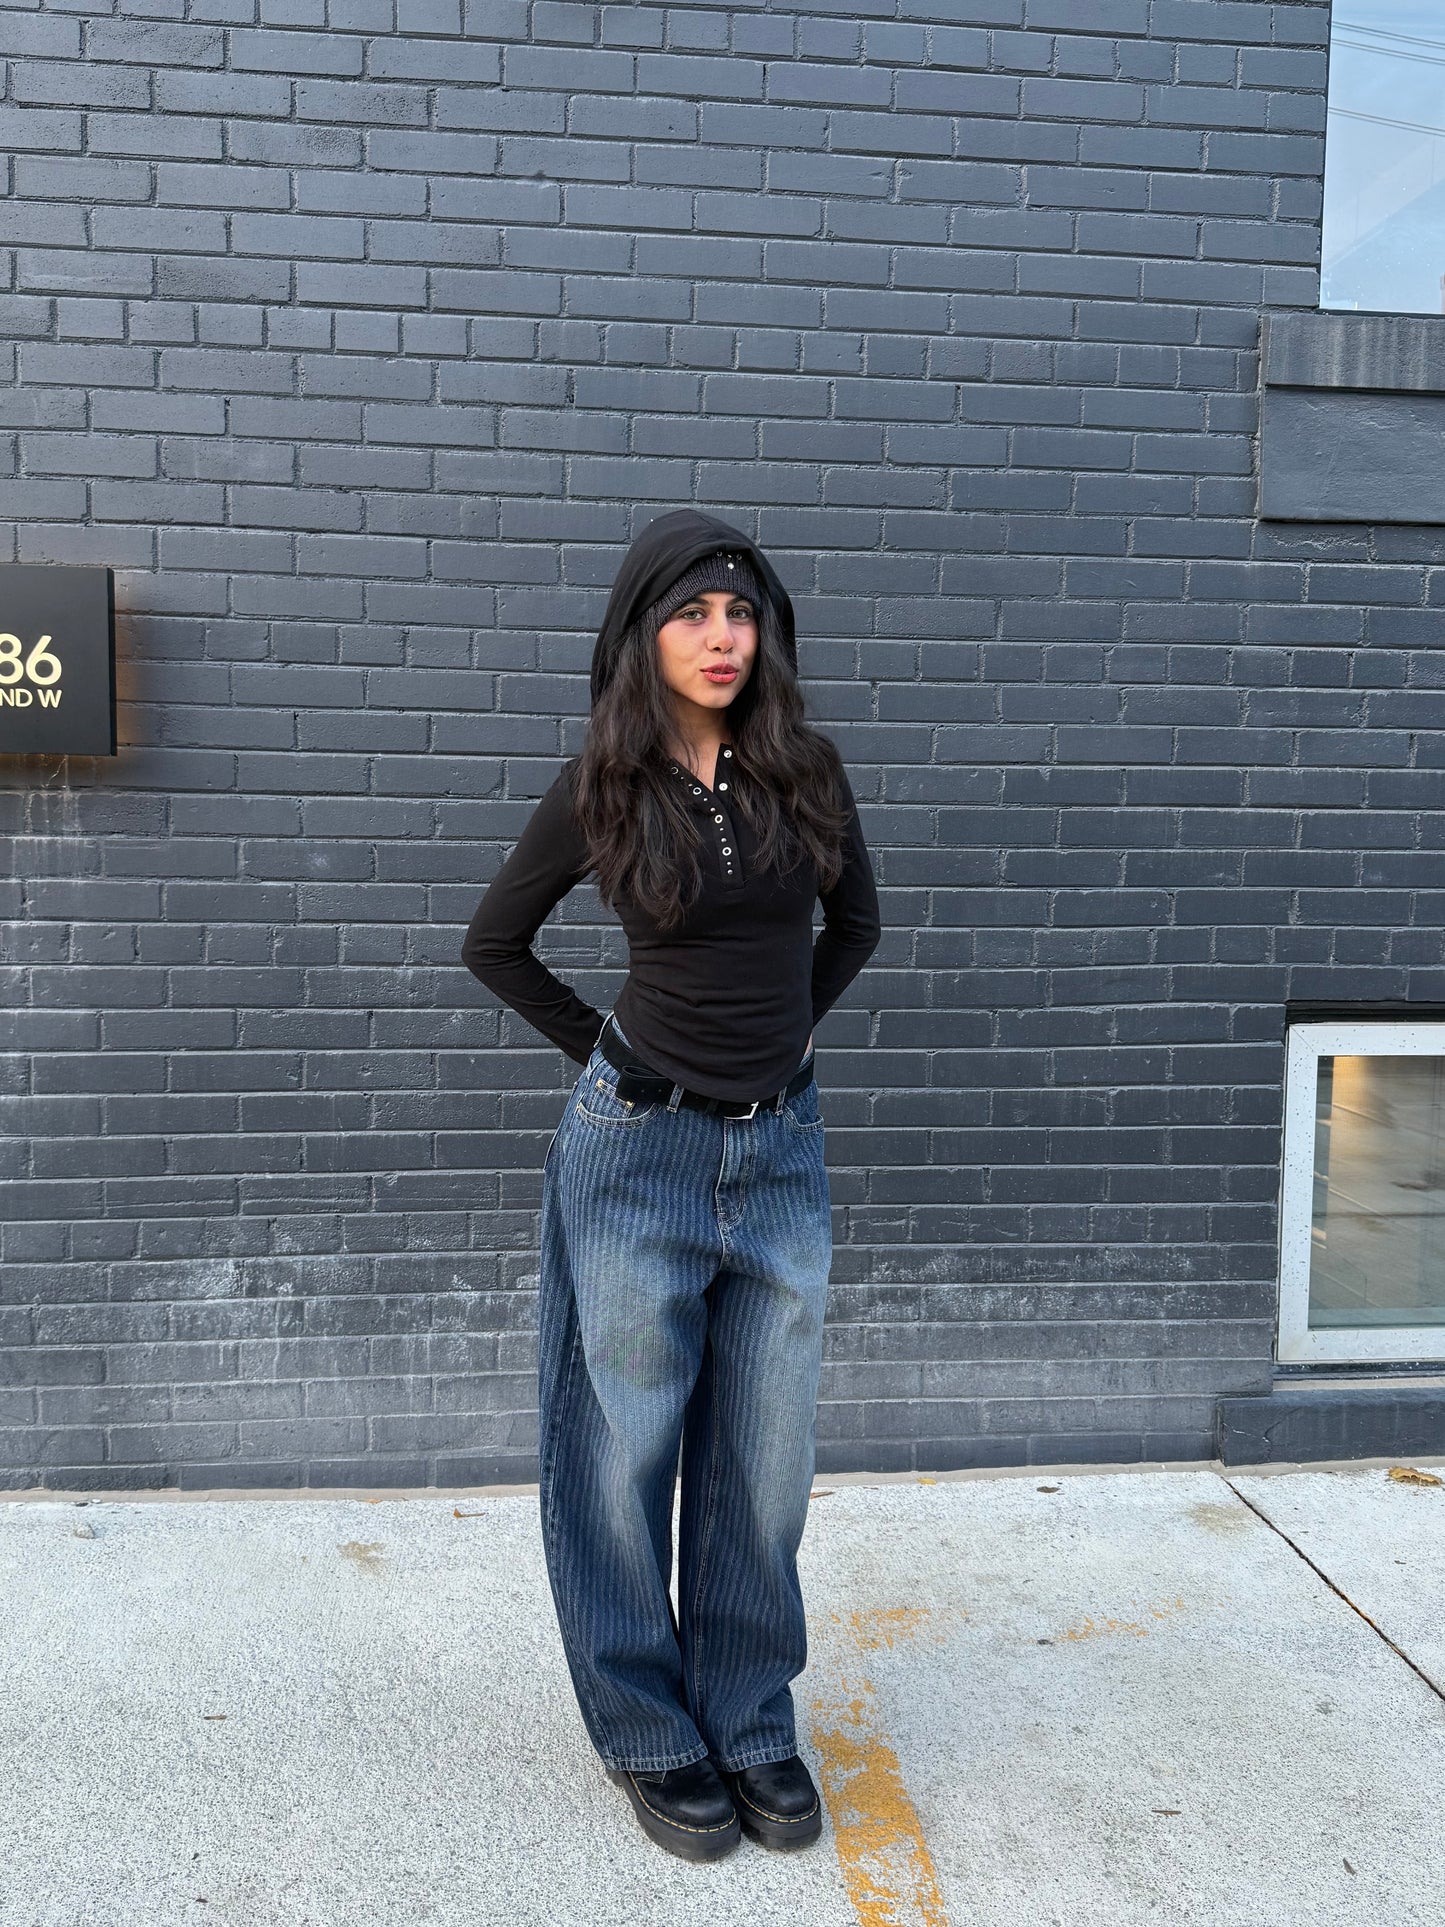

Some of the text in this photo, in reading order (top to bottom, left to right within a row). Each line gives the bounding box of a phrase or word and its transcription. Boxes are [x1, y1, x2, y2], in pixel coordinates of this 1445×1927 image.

[0, 633, 62, 685] 86
[0, 688, 62, 708] ND W
